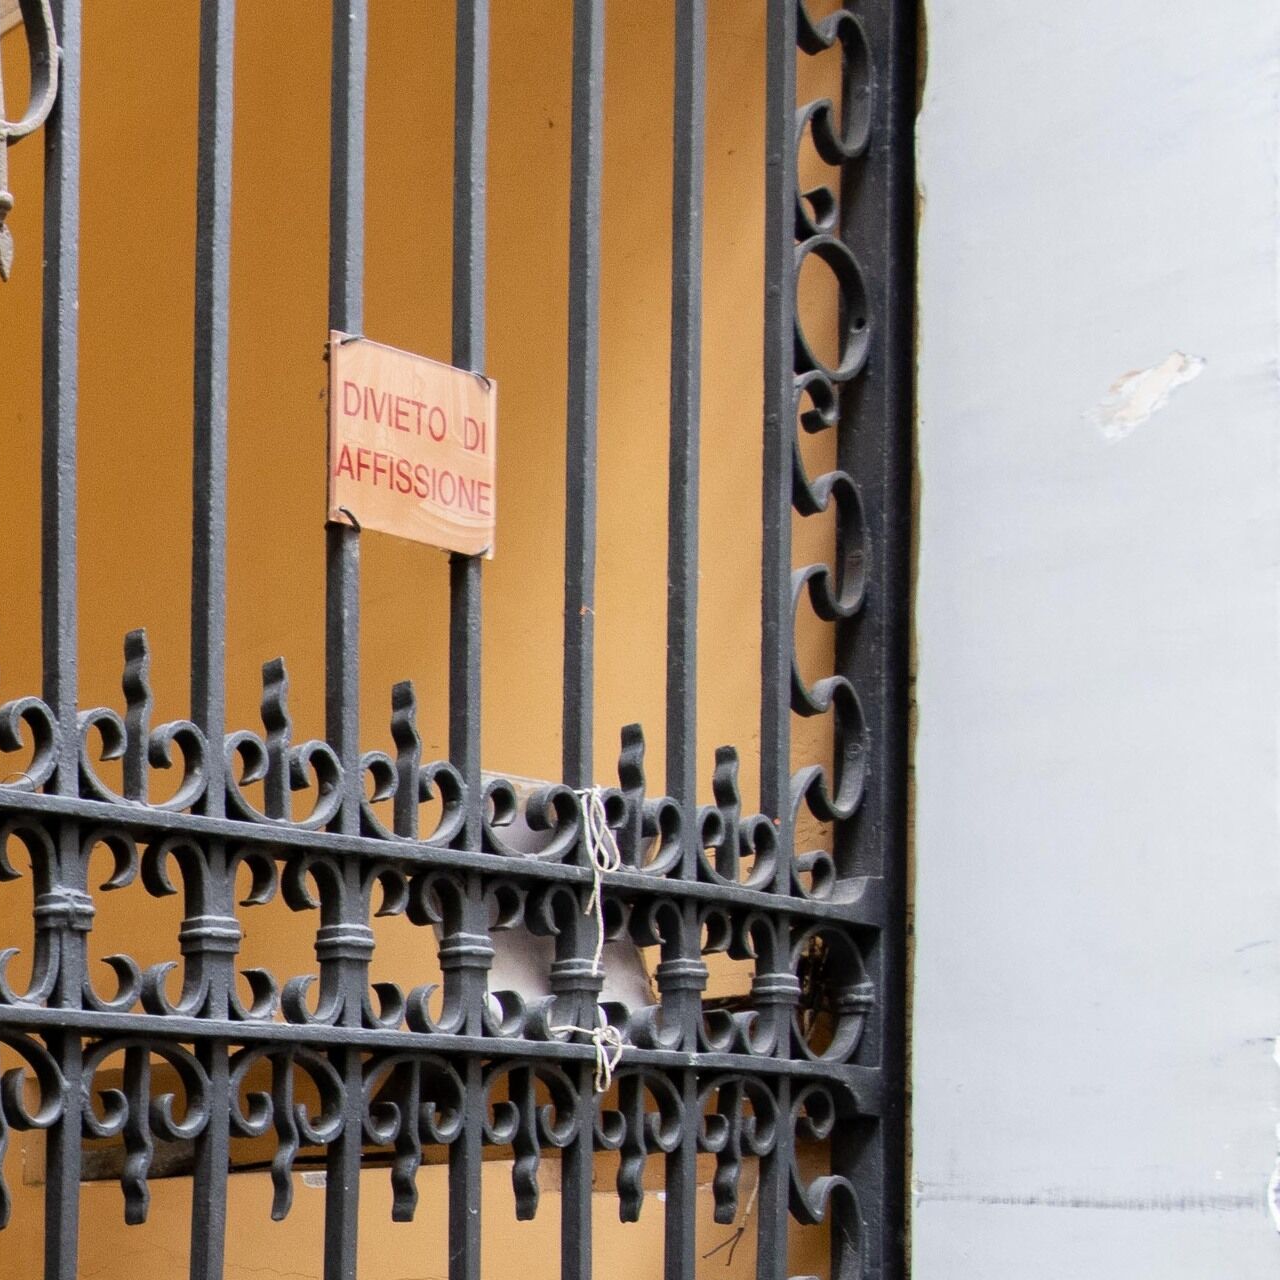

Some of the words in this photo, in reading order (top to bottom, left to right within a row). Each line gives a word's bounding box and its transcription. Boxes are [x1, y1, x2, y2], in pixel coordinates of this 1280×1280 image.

[343, 381, 447, 442] DIVIETO
[463, 416, 486, 454] DI
[335, 444, 491, 516] AFFISSIONE
